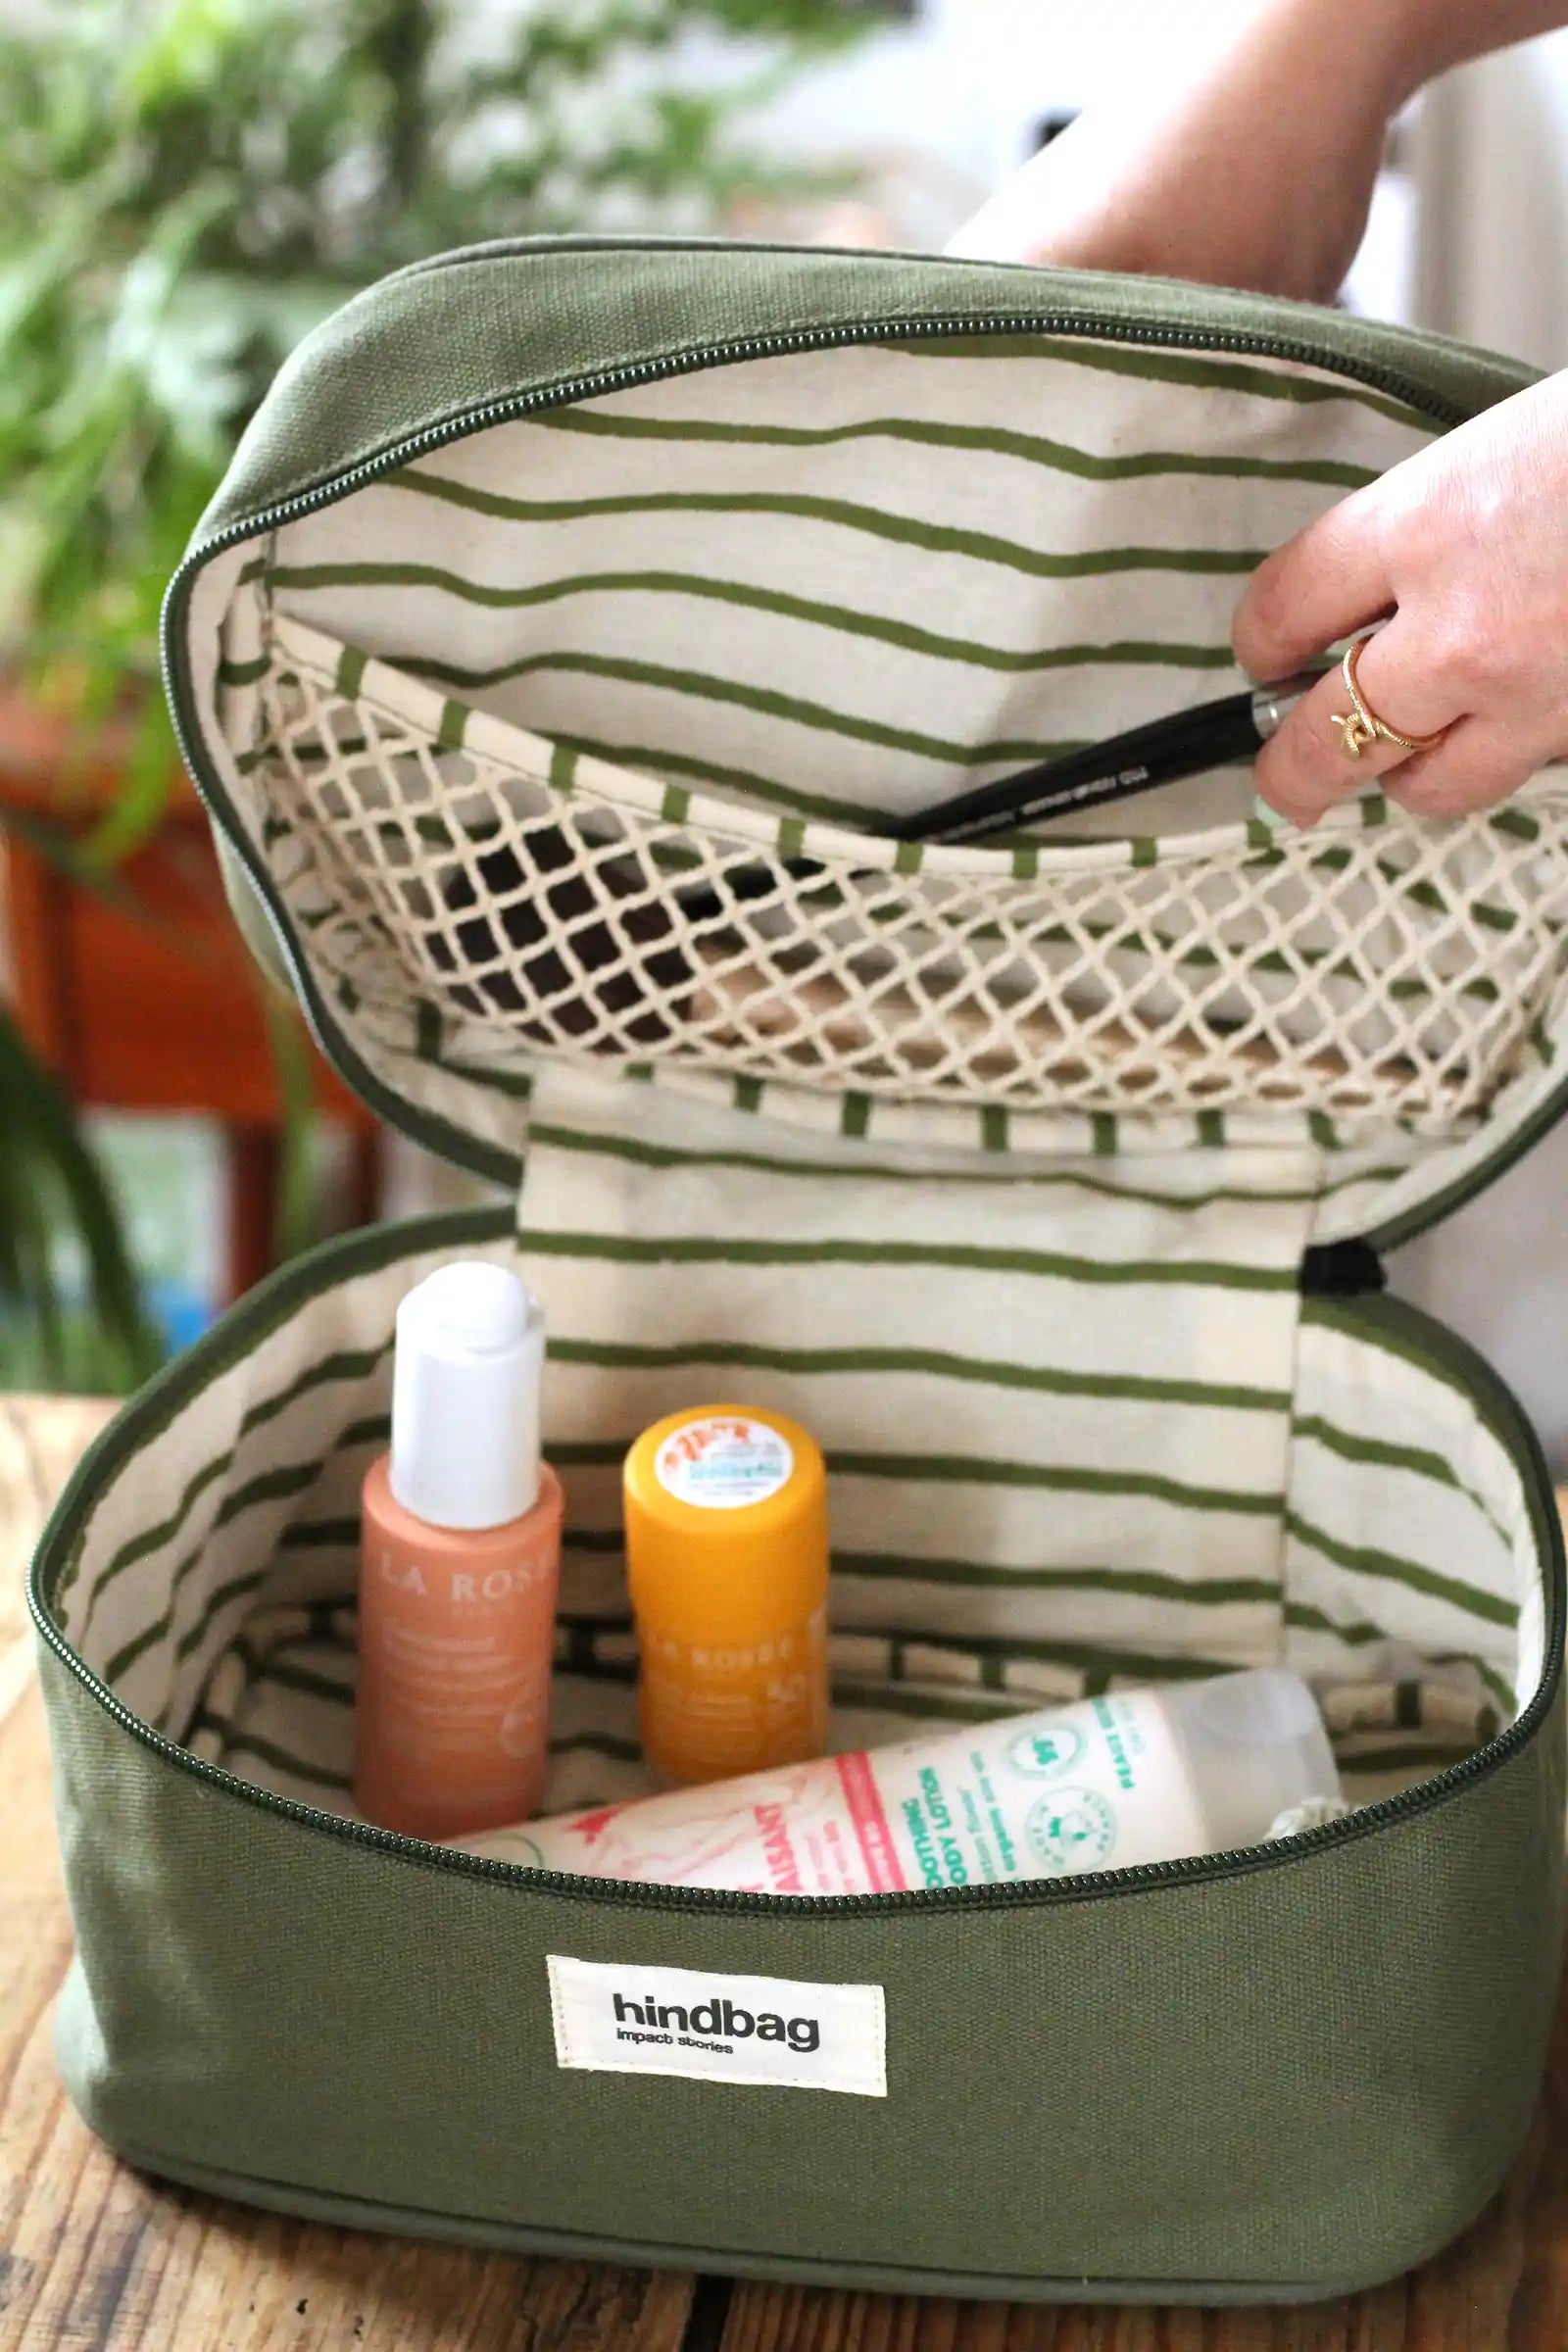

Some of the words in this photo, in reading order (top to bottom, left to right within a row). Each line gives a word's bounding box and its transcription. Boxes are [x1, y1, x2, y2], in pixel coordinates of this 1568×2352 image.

[753, 1802, 804, 1893] AISANT
[902, 1797, 946, 1889] OOTHING
[937, 1834, 969, 1886] ODY
[612, 1992, 820, 2054] hindbag
[616, 2027, 673, 2046] impact
[677, 2035, 734, 2055] stories
